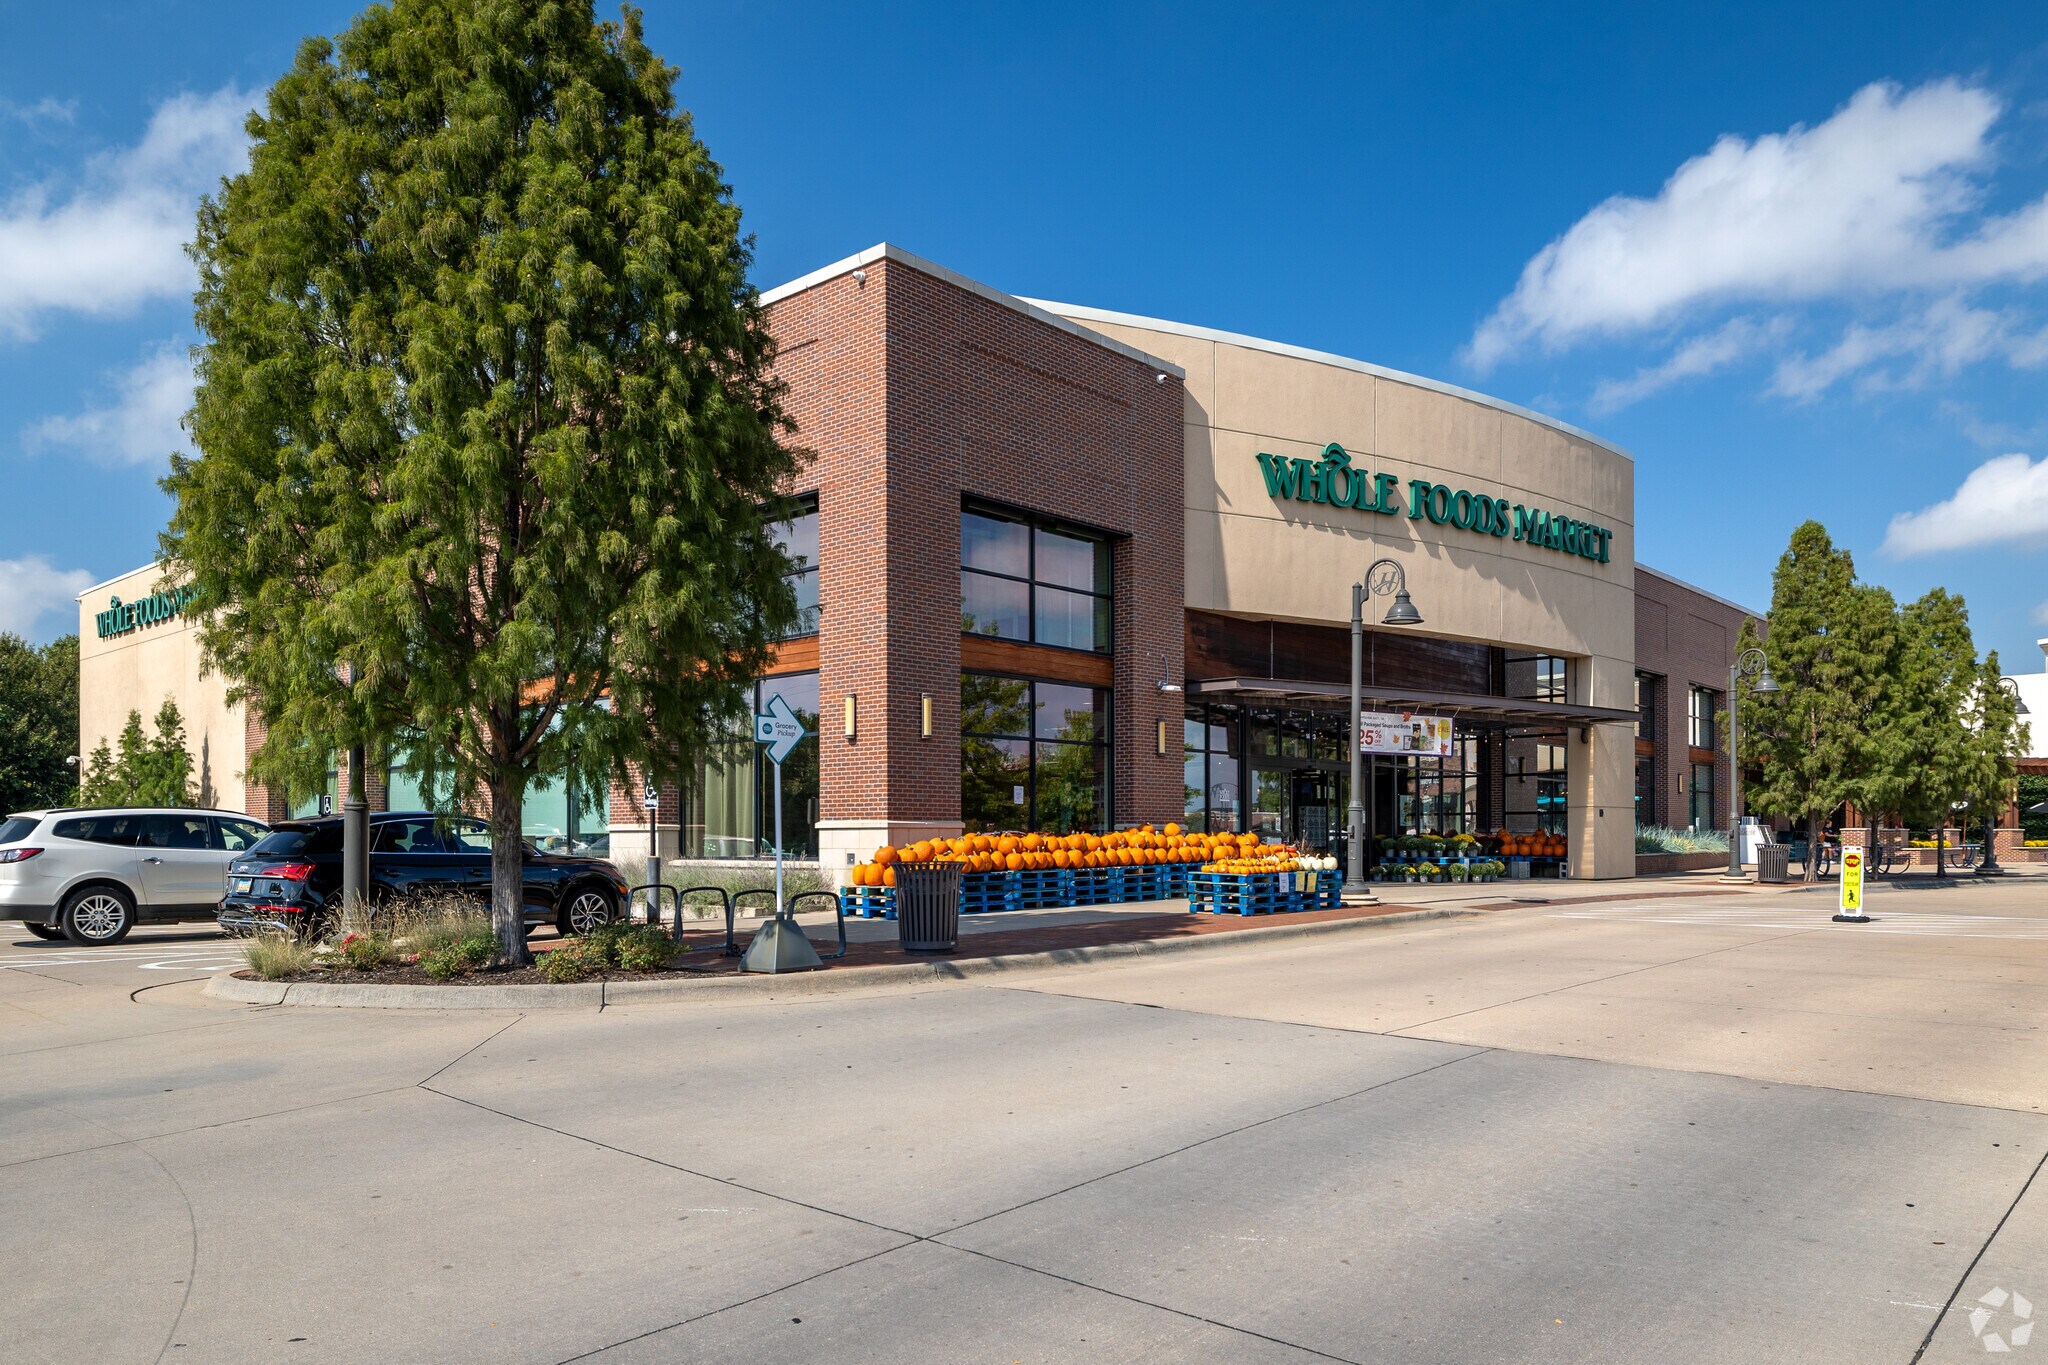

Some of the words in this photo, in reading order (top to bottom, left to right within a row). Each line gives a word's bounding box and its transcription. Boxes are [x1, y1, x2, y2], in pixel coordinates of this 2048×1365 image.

[1255, 442, 1400, 515] WHOLE
[1408, 479, 1510, 537] FOODS
[1512, 504, 1613, 563] MARKET
[95, 596, 132, 638] WHOLE
[135, 592, 172, 626] FOODS
[775, 722, 797, 730] Grocery
